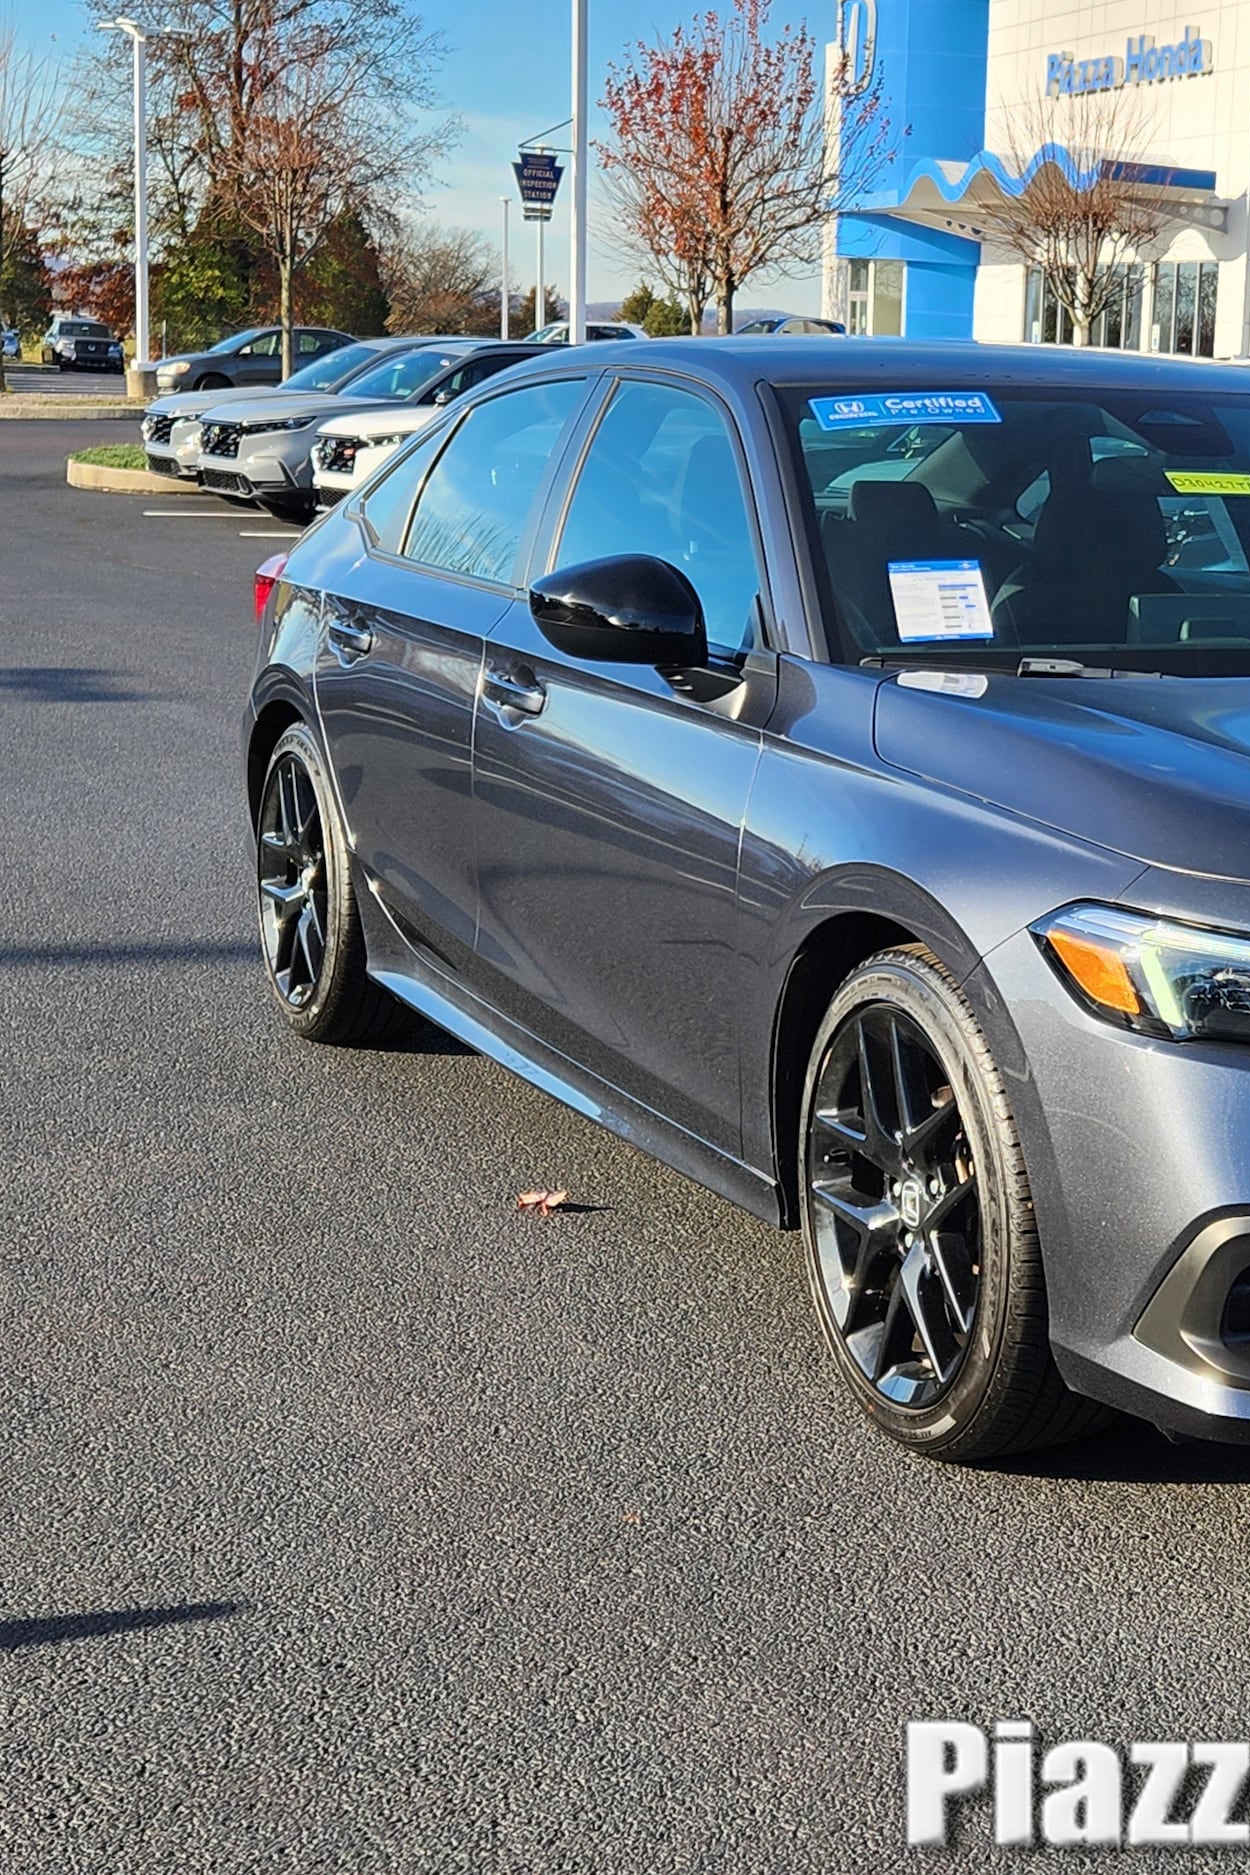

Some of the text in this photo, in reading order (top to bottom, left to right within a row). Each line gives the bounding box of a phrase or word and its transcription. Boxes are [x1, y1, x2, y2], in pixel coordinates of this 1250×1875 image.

[1046, 25, 1213, 100] Piazza Honda
[523, 169, 554, 179] OFFICIAL
[523, 190, 552, 199] STATION
[884, 397, 982, 409] Certified
